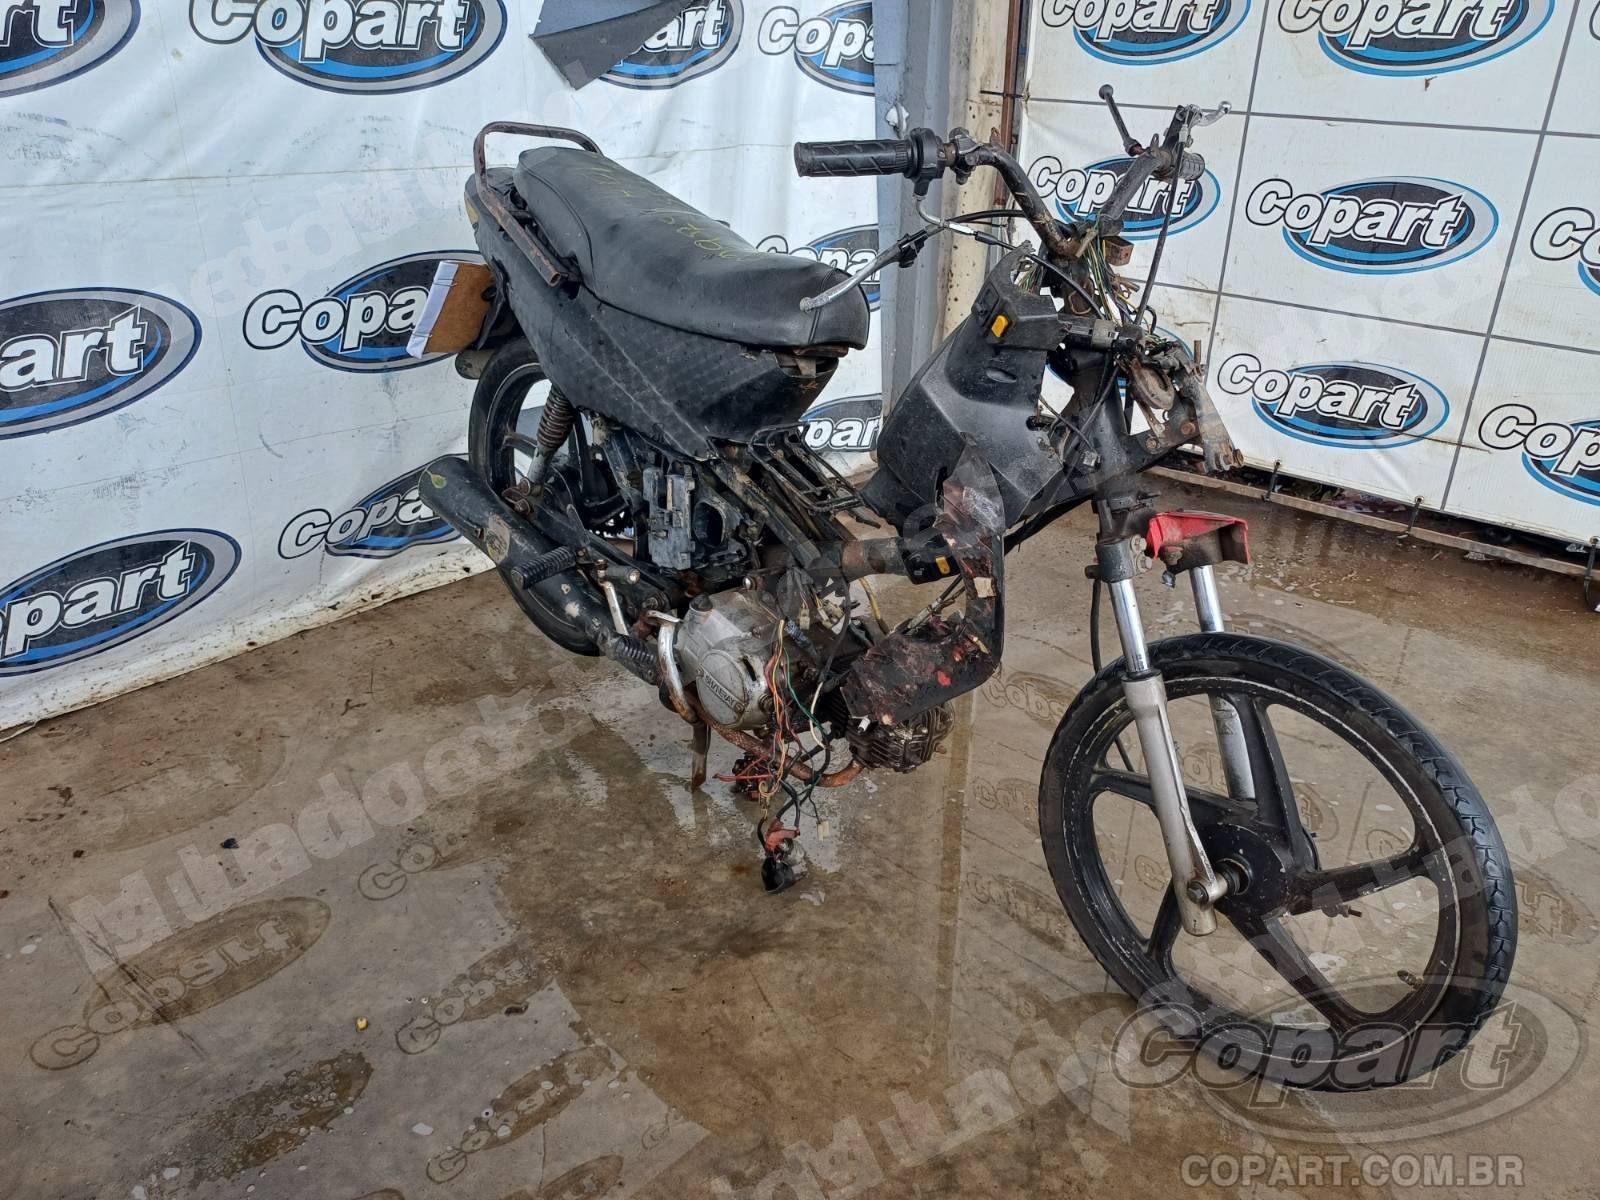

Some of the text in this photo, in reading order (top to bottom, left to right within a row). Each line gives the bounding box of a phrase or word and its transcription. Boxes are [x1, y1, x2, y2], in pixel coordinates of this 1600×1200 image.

[189, 0, 471, 63] Copart
[1041, 0, 1213, 43] Copart
[1277, 0, 1516, 49] Copart
[1246, 178, 1466, 249] Copart
[1217, 353, 1420, 428] Copart
[0, 540, 197, 658] part
